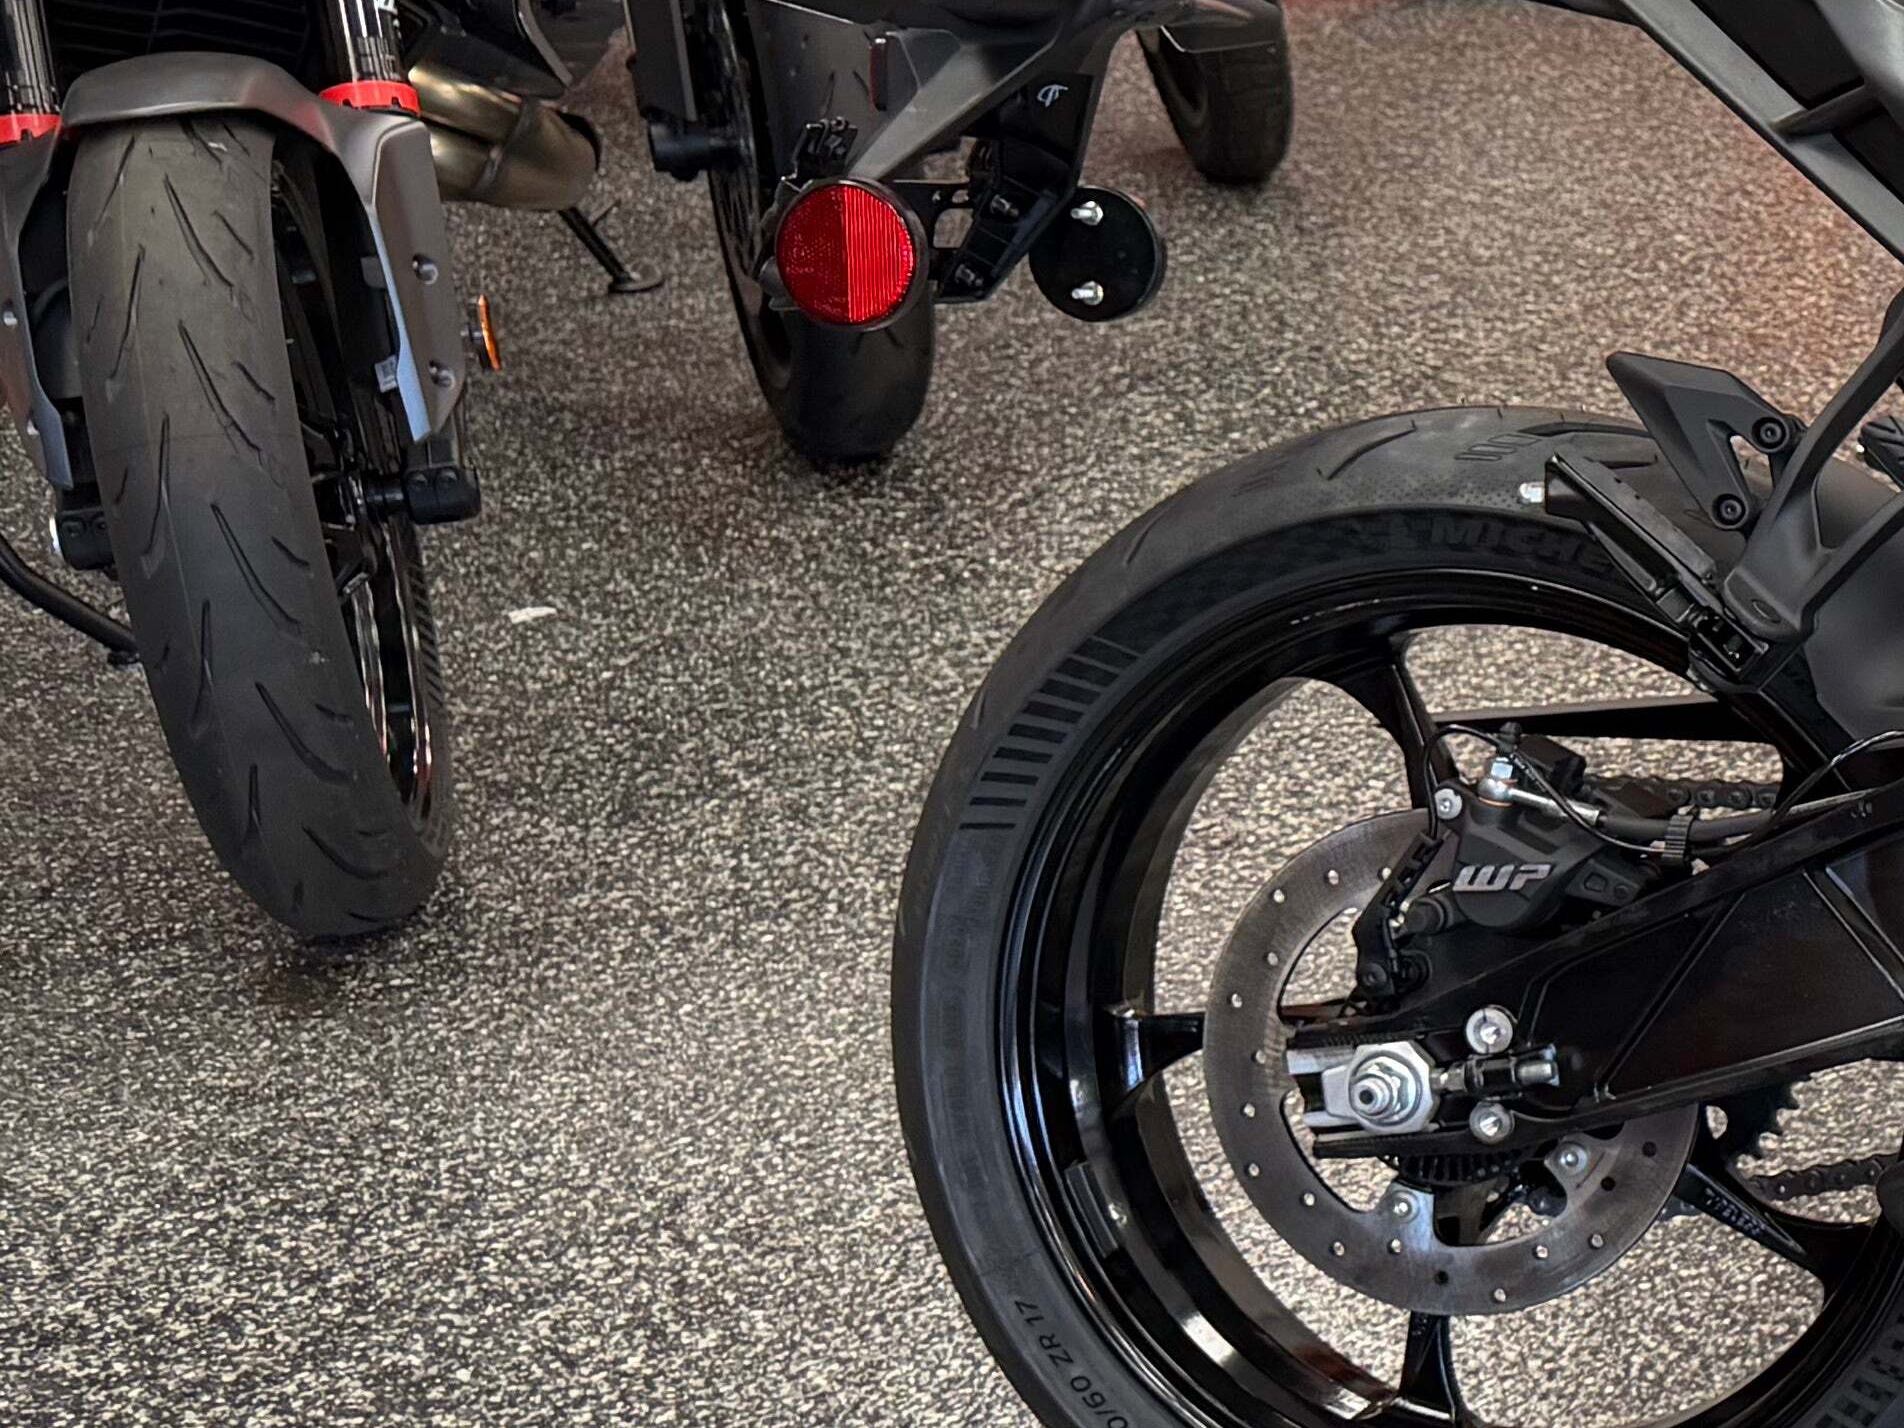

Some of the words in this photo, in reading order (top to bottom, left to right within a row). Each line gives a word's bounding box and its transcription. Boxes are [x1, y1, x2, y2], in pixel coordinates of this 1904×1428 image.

[1452, 863, 1551, 892] WP
[1013, 1299, 1046, 1329] 17
[1038, 1333, 1075, 1369] ZR
